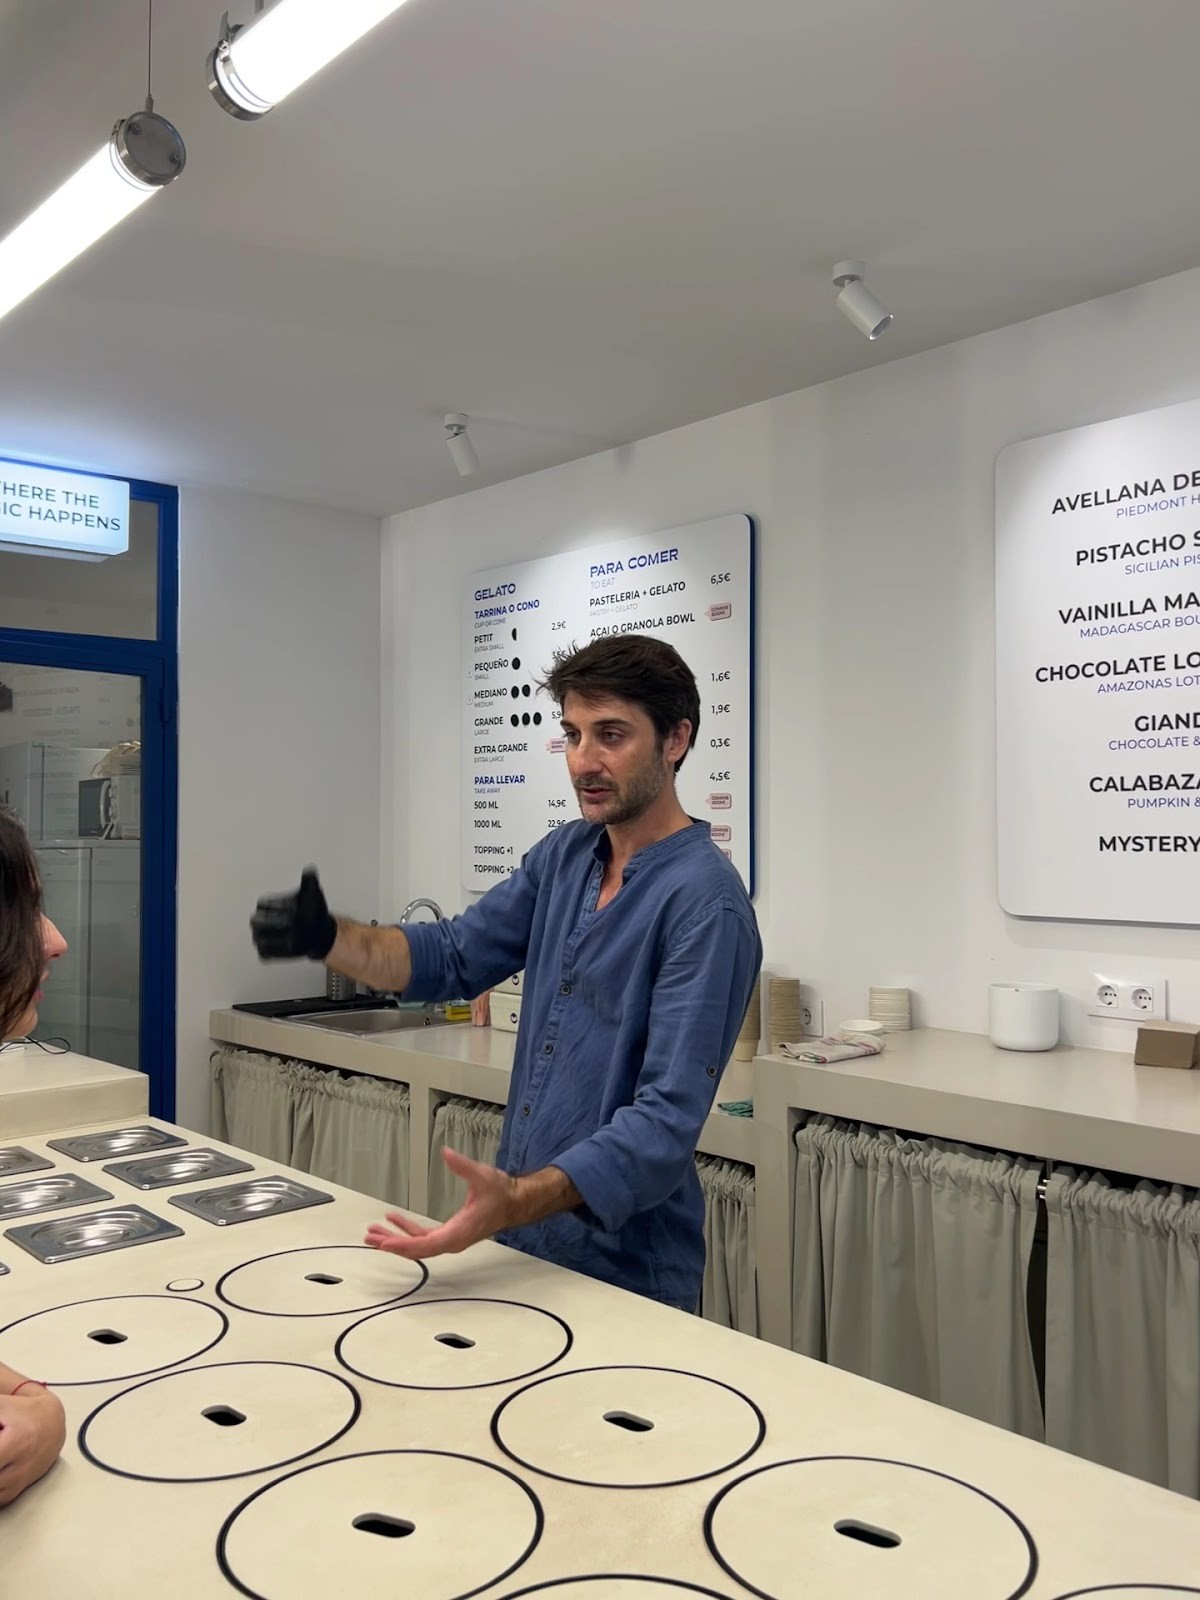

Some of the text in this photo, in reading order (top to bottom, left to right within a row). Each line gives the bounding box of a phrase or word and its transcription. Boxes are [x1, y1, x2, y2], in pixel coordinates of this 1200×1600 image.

[0, 480, 99, 508] HERE THE
[1052, 478, 1166, 514] AVELLANA
[1116, 496, 1187, 518] PIEDMONT
[0, 502, 120, 530] IC HAPPENS
[1077, 534, 1186, 565] PISTACHO
[590, 548, 679, 578] PARA COMER
[1125, 558, 1179, 574] SICILIAN
[591, 577, 615, 589] TO EAT
[710, 573, 731, 585] 6,5€
[475, 583, 516, 601] GELATO
[590, 590, 640, 607] PASTELERIA
[649, 581, 685, 596] GELATO
[475, 600, 540, 619] TARRINA O CONO
[615, 604, 638, 613] GELATO
[1059, 592, 1200, 624] VAINILLA MA
[475, 621, 485, 629] CUP
[612, 625, 619, 634] O
[620, 616, 664, 632] GRANOLA
[667, 613, 695, 625] BOWL
[1080, 618, 1170, 638] MADAGASCAR
[475, 621, 566, 644] PETIT 2,9€
[475, 659, 508, 671] PEQUEÑO
[1036, 652, 1200, 682] CHOCOLATE LO
[711, 671, 730, 682] 1,6€
[1098, 675, 1200, 694] AMAZONAS LOT
[475, 688, 507, 699] MEDIANO
[711, 704, 730, 715] 1,9€
[475, 711, 562, 726] GRANDE 5,9
[475, 743, 527, 754] EXTRA GRANDE
[710, 738, 730, 748] 0,3€
[1109, 737, 1189, 750] CHOCOLATE
[475, 775, 525, 785] PARA LLEVAR
[710, 771, 730, 781] 4,5€
[474, 801, 498, 809] 500 ML
[548, 799, 566, 808] 14,9€
[1128, 797, 1189, 808] PUMPKIN
[474, 820, 501, 828] 1000 ML
[474, 846, 505, 854] TOPPING
[1099, 836, 1200, 852] MYSTERY
[474, 865, 504, 873] TOPPING
